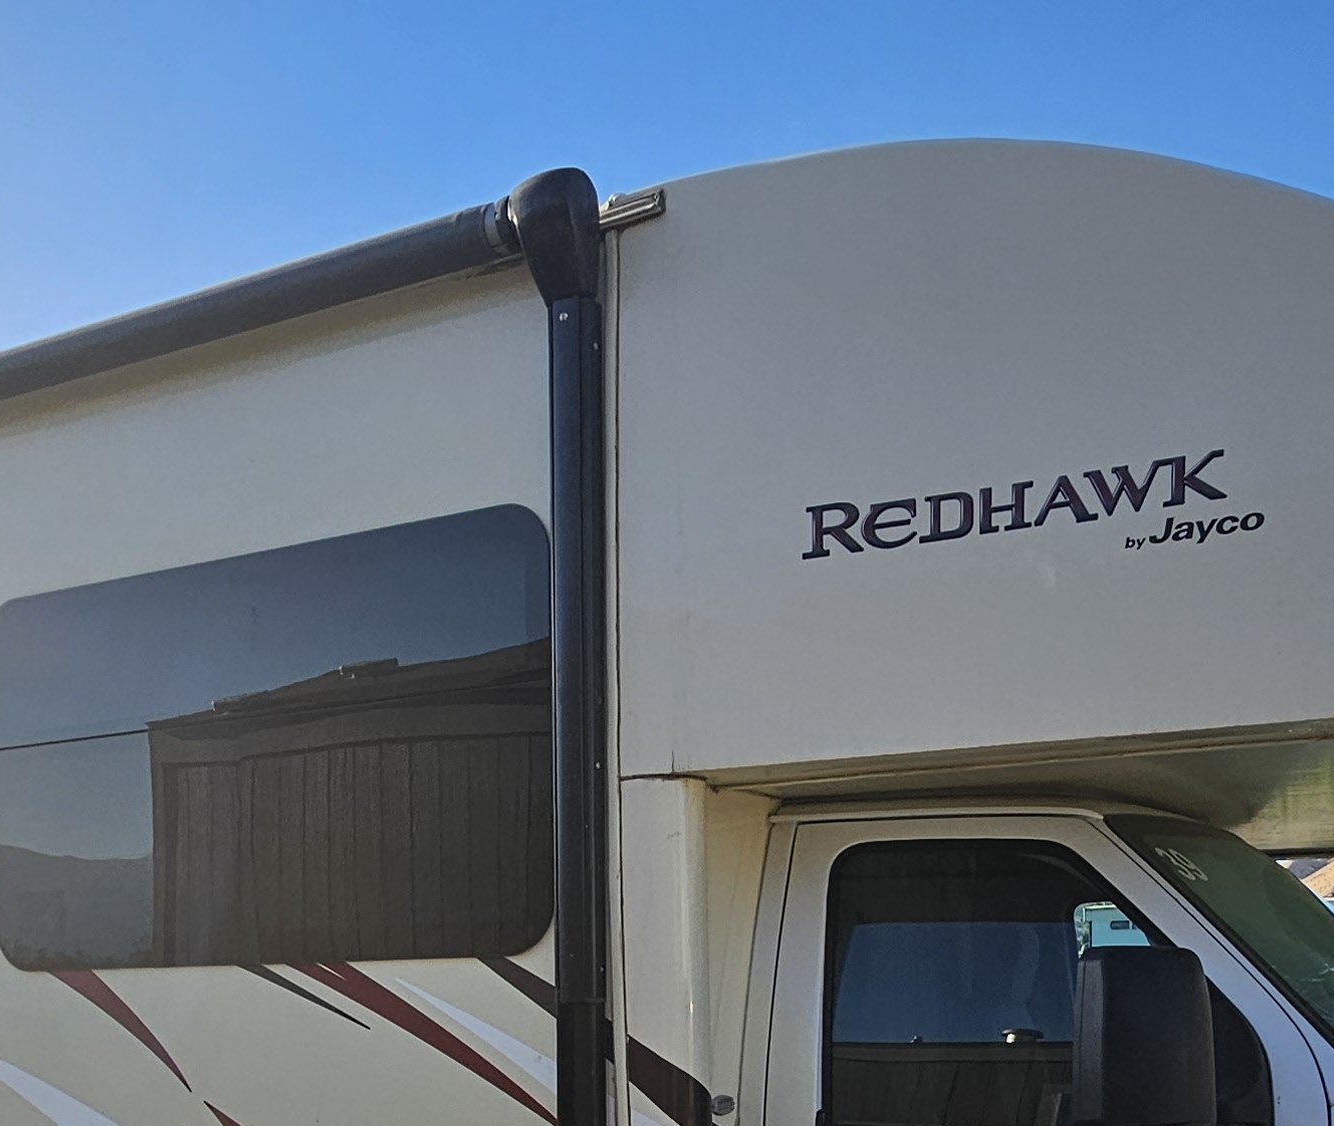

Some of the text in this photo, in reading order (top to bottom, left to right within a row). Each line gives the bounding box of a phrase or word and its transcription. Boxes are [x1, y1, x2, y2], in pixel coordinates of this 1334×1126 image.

[801, 448, 1228, 560] REDHAWK
[1124, 512, 1266, 551] by Jayco
[1154, 847, 1209, 881] 39
